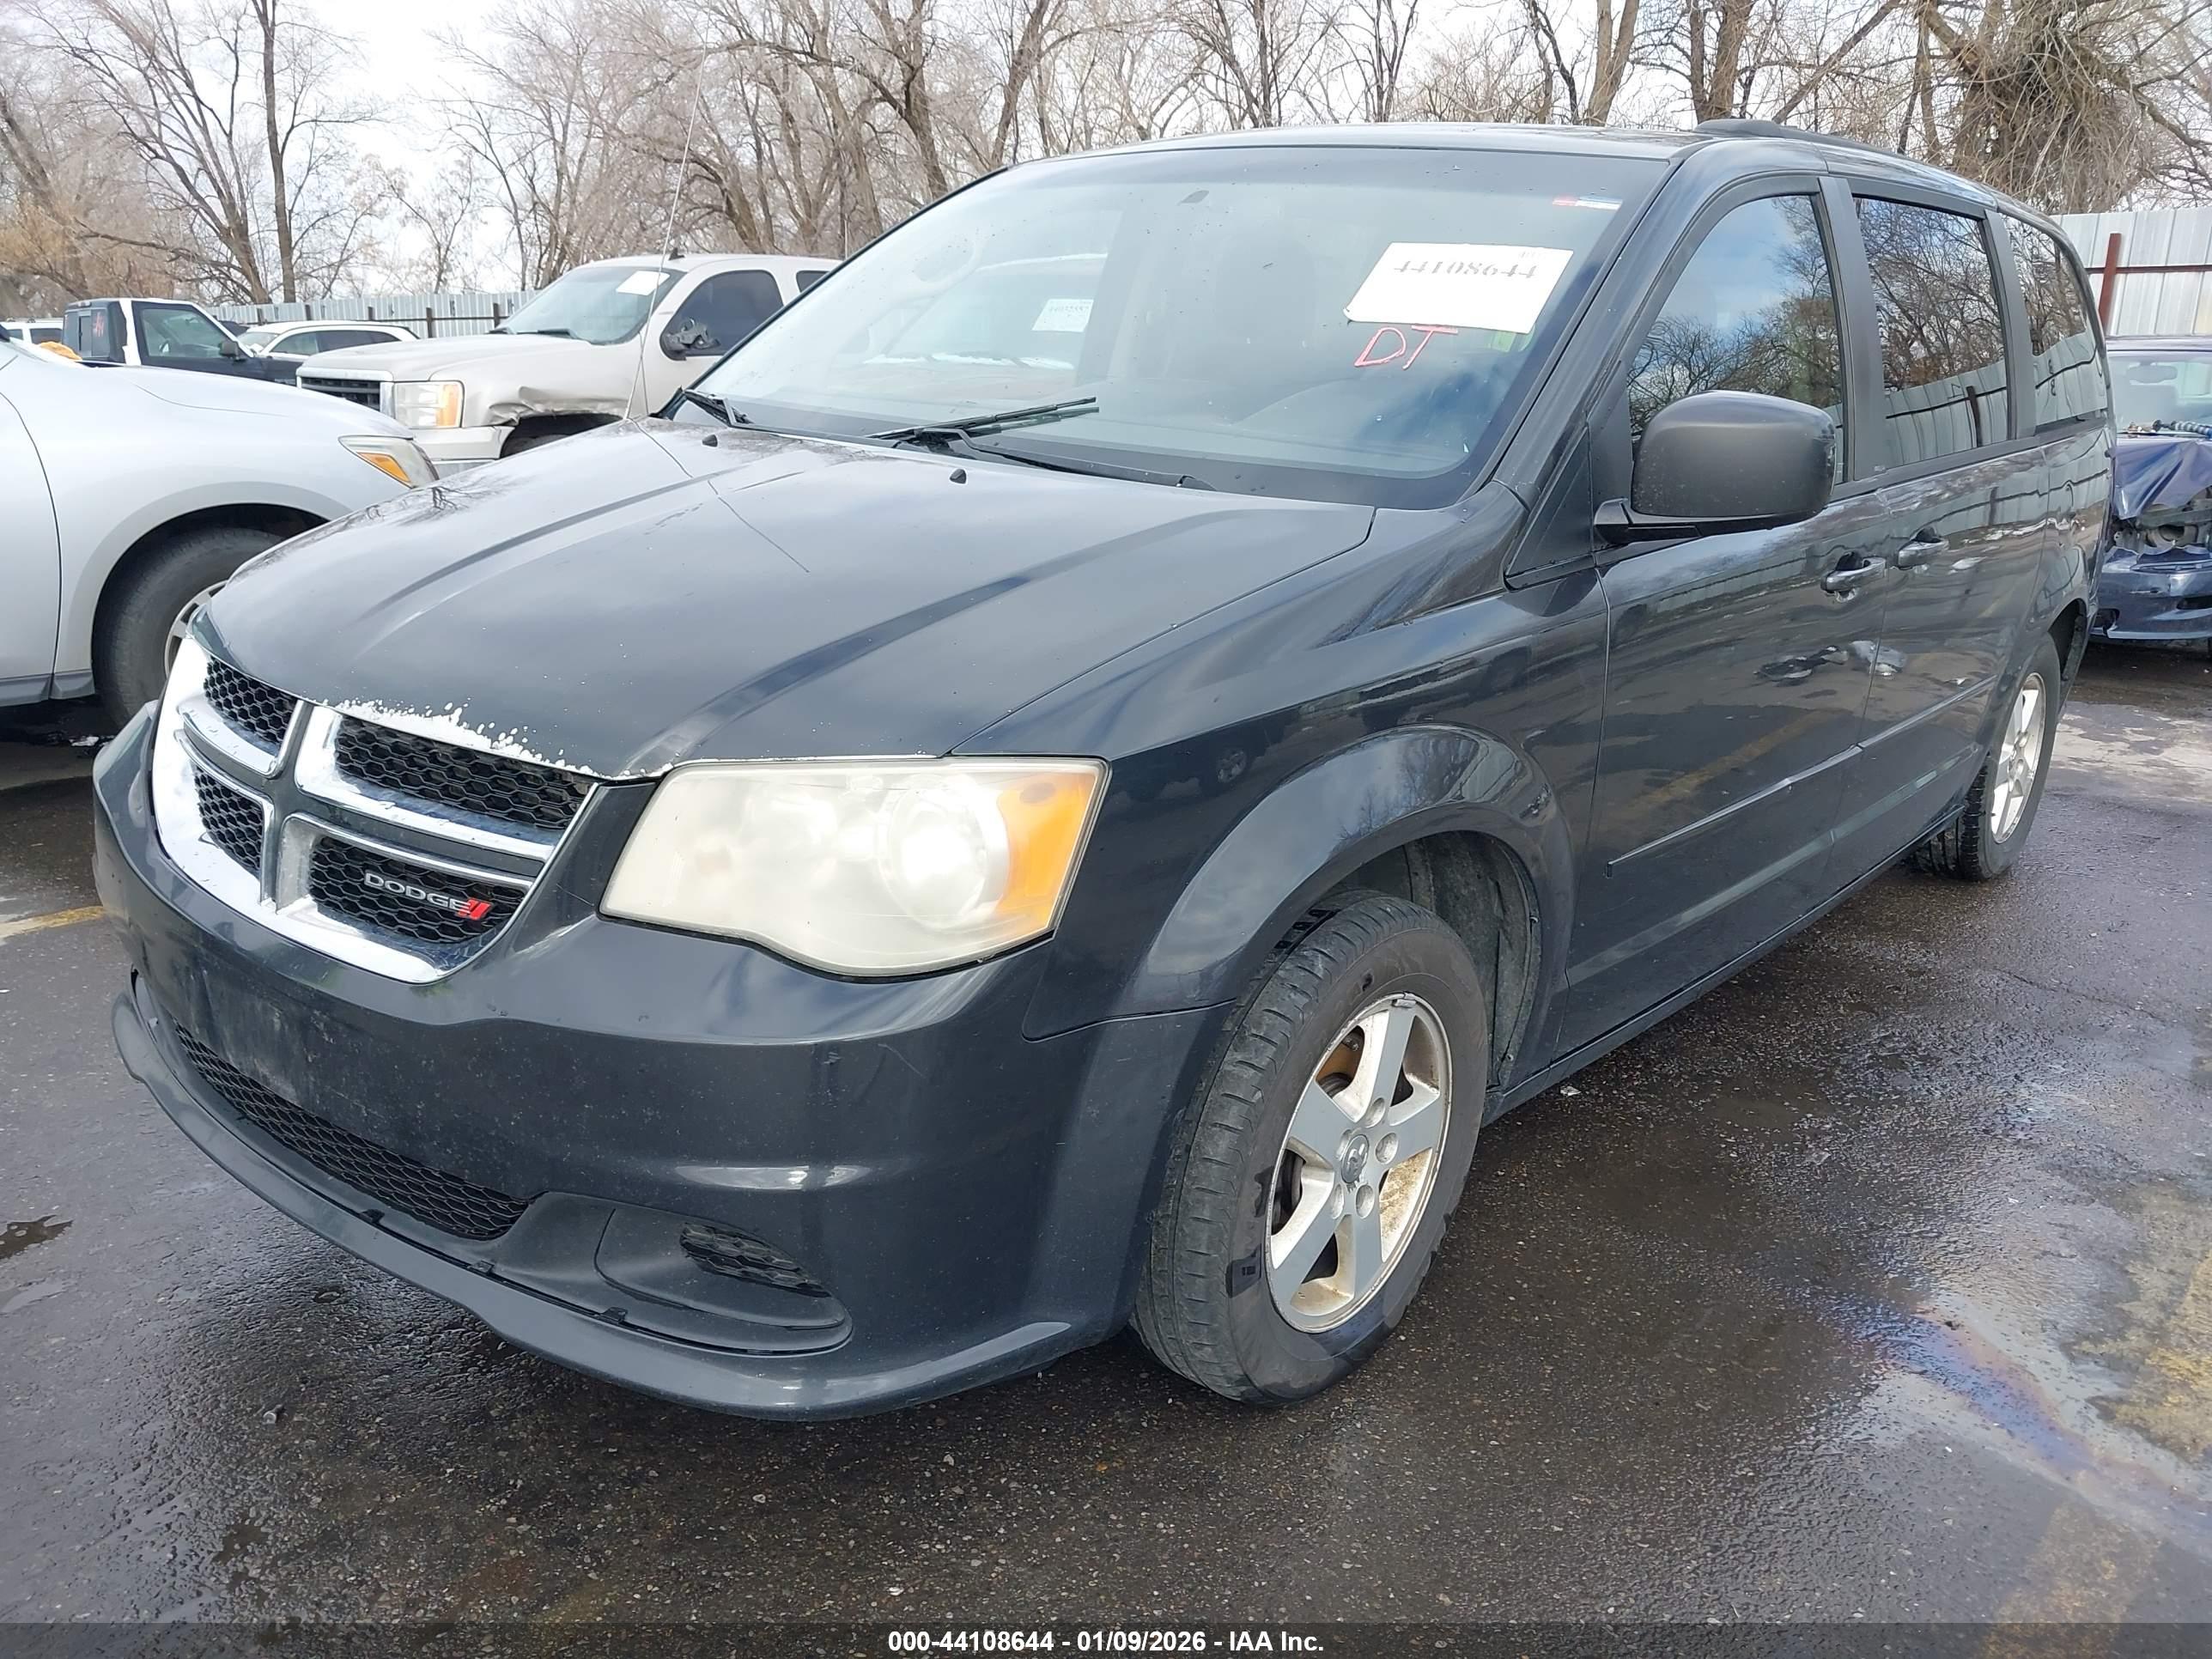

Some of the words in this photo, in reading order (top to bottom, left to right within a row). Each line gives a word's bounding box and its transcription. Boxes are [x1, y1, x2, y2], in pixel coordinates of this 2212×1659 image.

[1394, 260, 1537, 279] 44108644
[1353, 325, 1458, 371] DT
[364, 872, 471, 915] DODGE
